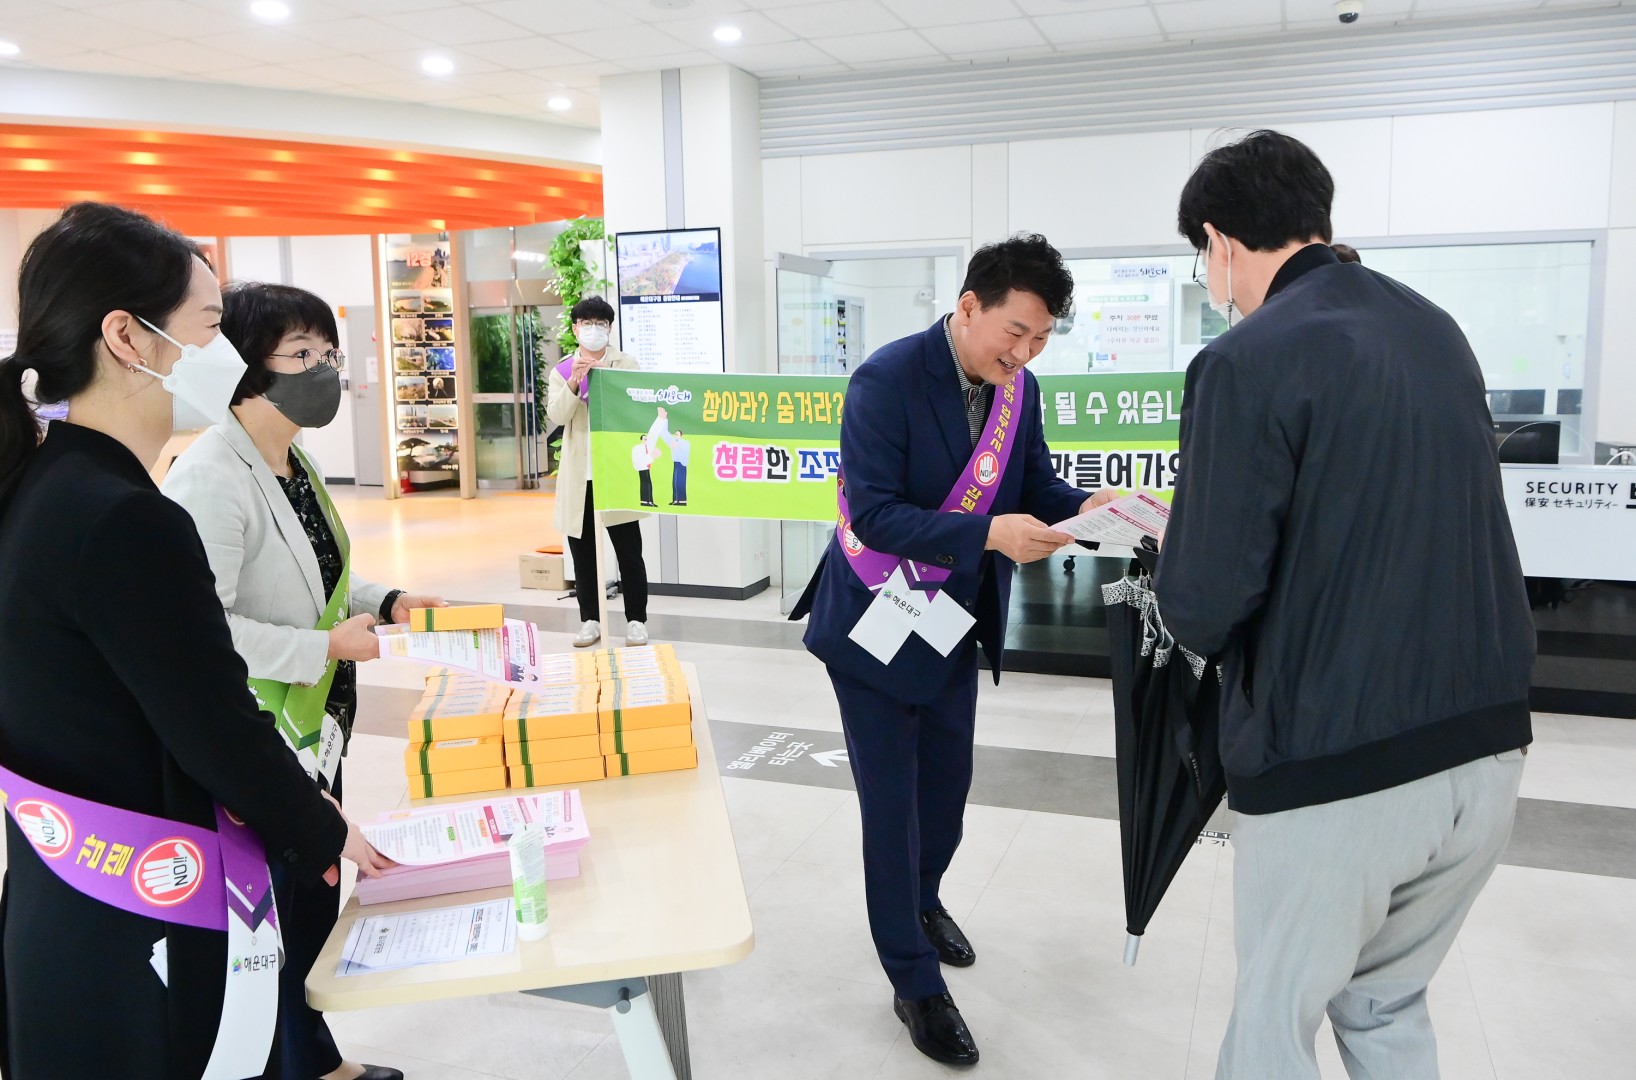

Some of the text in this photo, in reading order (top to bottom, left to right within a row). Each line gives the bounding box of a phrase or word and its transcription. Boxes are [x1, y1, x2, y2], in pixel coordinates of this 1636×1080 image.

[702, 389, 769, 423] 참아라?
[776, 391, 844, 425] 숨겨라?
[1055, 391, 1077, 425] 될
[1086, 391, 1108, 425] 수
[715, 444, 790, 480] 청렴한
[1525, 497, 1619, 509] 保安 セキュリティー
[1526, 481, 1618, 495] SECURITY
[892, 595, 921, 618] 해운대구
[324, 723, 338, 758] 해운대구
[727, 731, 795, 770] 엘리베이터
[40, 818, 57, 845] NO!!
[75, 833, 135, 877] 갑질
[172, 856, 189, 887] NO!!
[243, 953, 276, 972] 해운대구
